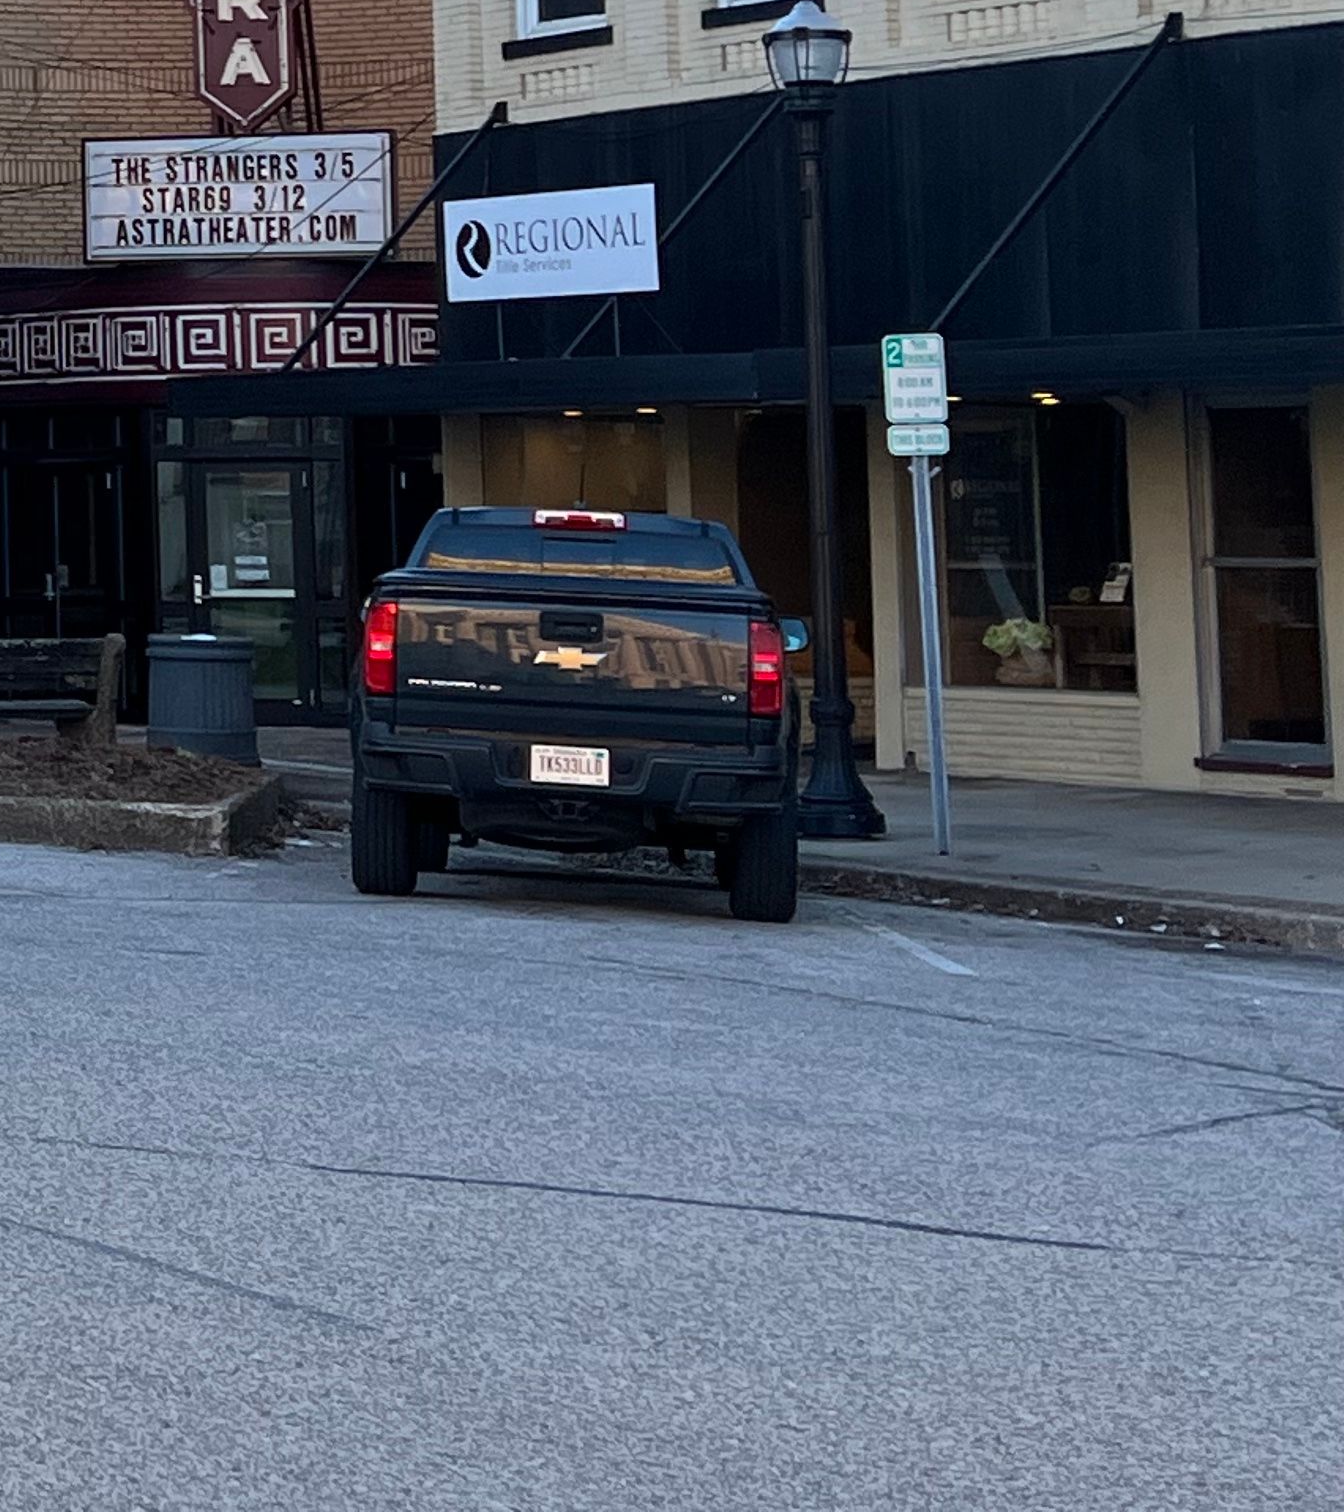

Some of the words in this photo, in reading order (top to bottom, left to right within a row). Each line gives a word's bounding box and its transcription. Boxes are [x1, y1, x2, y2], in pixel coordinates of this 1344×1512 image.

[111, 157, 151, 185] THE
[165, 152, 299, 183] STRANGERS
[315, 152, 354, 179] 3/5
[143, 186, 231, 214] STAR69
[254, 185, 305, 211] 3/12
[116, 215, 357, 245] ASTRATHEATER.COM
[494, 212, 646, 256] REGIONAL
[887, 341, 901, 365] 2
